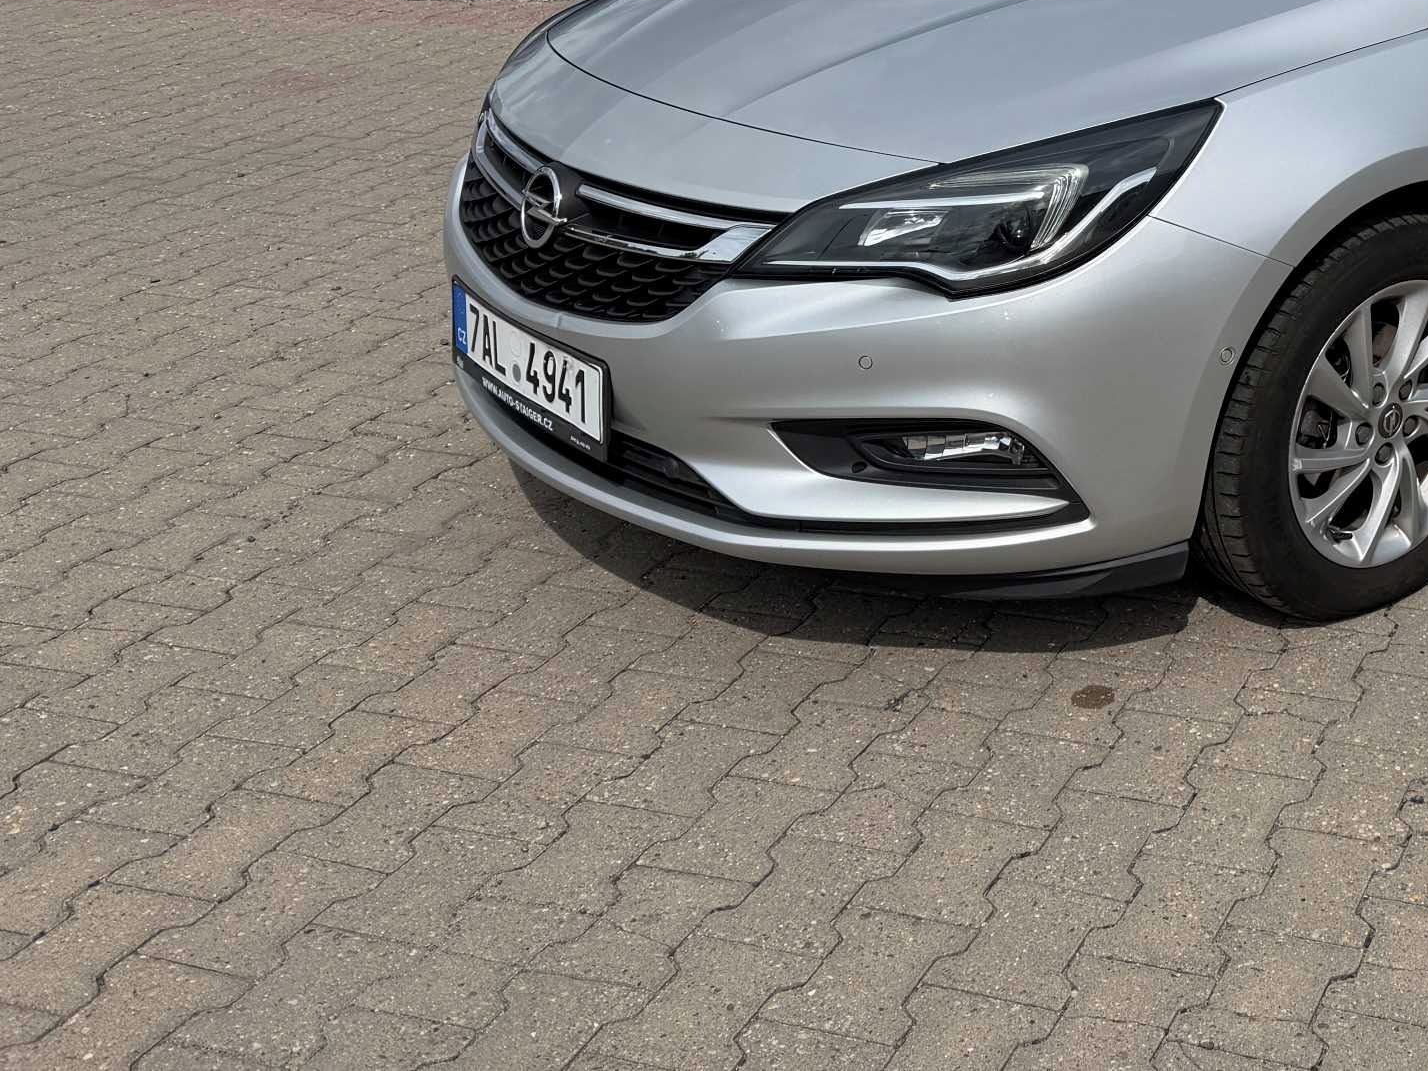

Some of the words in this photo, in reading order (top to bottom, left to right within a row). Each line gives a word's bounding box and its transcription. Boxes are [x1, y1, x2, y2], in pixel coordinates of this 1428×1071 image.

[457, 327, 467, 345] CZ
[469, 303, 506, 376] 7AL
[526, 342, 586, 425] 4941
[481, 376, 553, 431] WWW.AUTO-STAIGER.CZ
